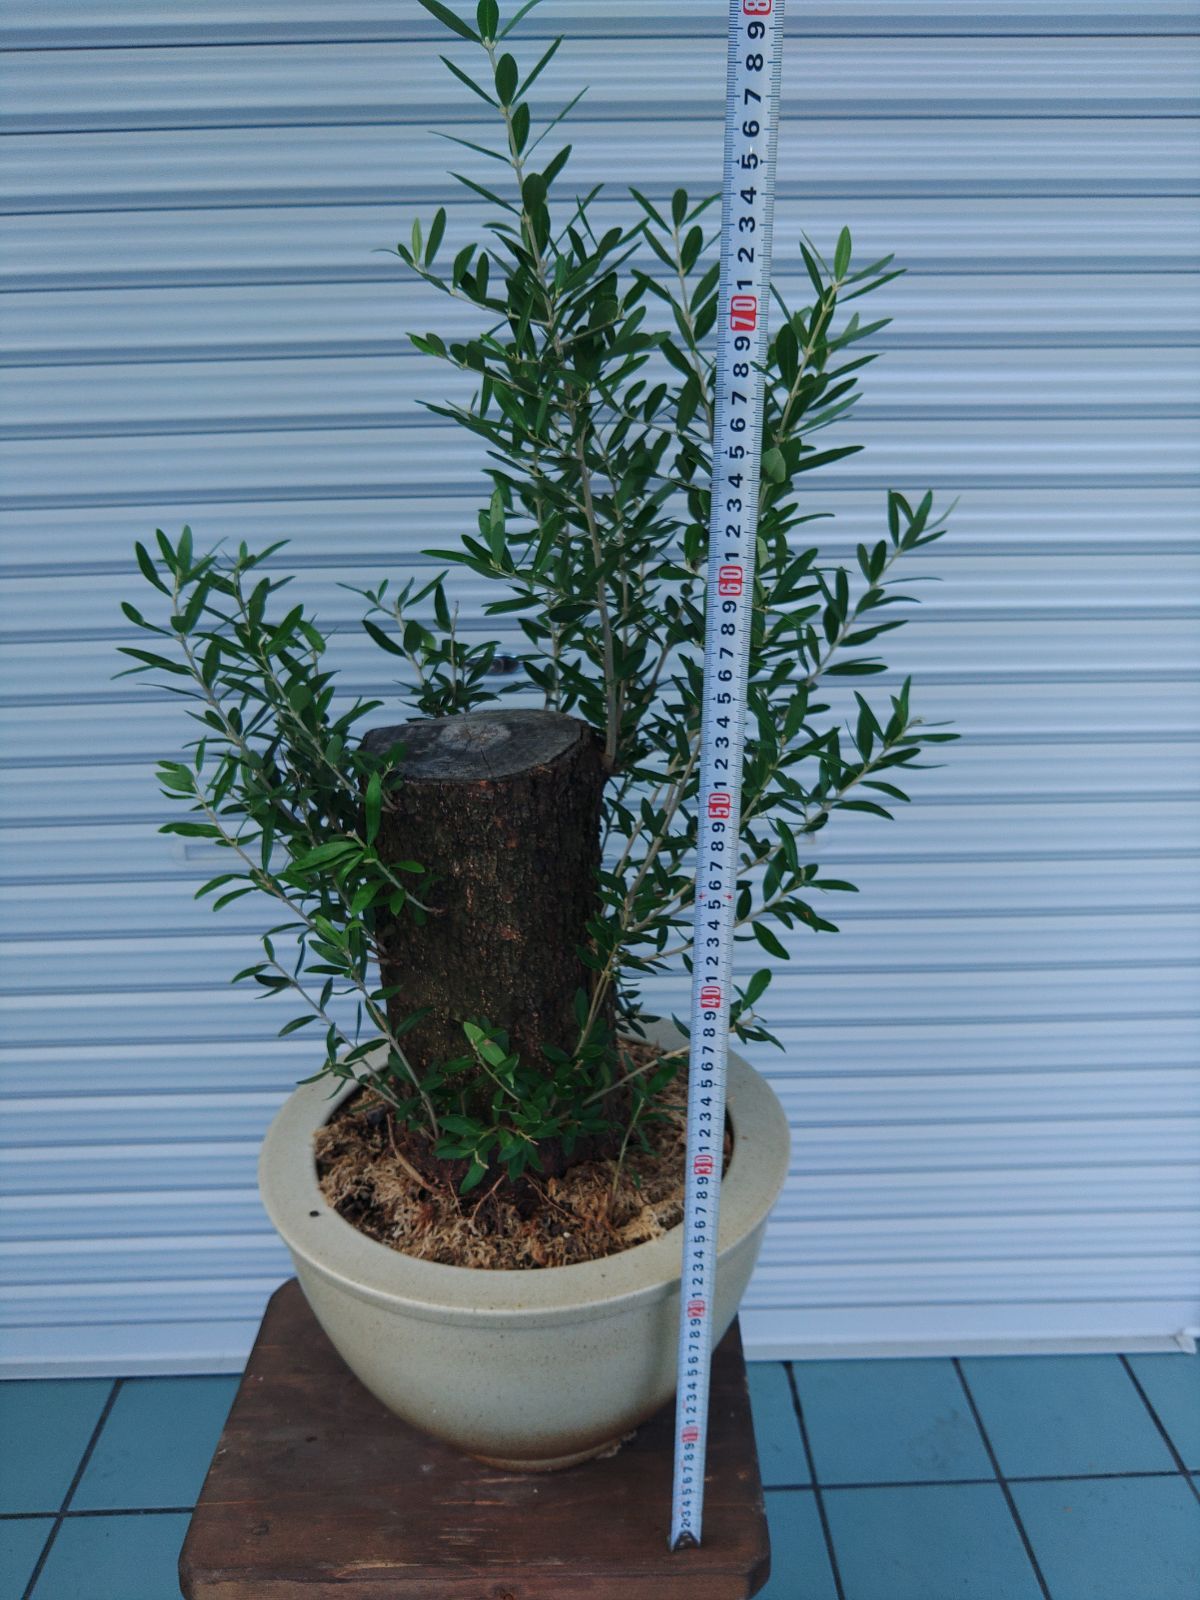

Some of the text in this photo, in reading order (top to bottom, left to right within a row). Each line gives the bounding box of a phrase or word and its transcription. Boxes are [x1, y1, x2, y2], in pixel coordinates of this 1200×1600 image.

[745, 0, 770, 12] 8
[747, 21, 765, 39] 9
[746, 53, 764, 72] 8
[744, 88, 762, 105] 7
[742, 120, 760, 137] 6
[741, 153, 758, 170] 5
[740, 186, 757, 204] 4
[739, 216, 756, 233] 3
[737, 247, 754, 263] 2
[736, 280, 753, 290] 1
[732, 297, 756, 330] 70
[734, 336, 750, 351] 9
[733, 363, 749, 378] 8
[732, 391, 747, 405] 7
[730, 417, 746, 432] 6
[729, 445, 744, 459] 5
[728, 473, 743, 488] 4
[727, 498, 742, 512] 3
[726, 525, 741, 538] 2
[725, 552, 739, 561] 1
[719, 566, 742, 596] 60
[722, 600, 737, 613] 9
[721, 623, 735, 636] 8
[720, 647, 734, 659] 7
[718, 670, 732, 681] 6
[717, 693, 731, 704] 5
[716, 716, 730, 729] 4
[715, 737, 729, 748] 3
[714, 759, 728, 770] 2
[714, 781, 727, 789] 1
[709, 793, 730, 818] 50
[712, 822, 725, 832] 9
[711, 841, 724, 852] 8
[709, 862, 723, 871] 7
[708, 880, 722, 891] 6
[708, 899, 721, 910] 5
[707, 920, 720, 931] 4
[706, 937, 719, 948] 3
[706, 956, 718, 966] 2
[701, 986, 720, 1008] 40
[704, 1011, 717, 1021] 9
[703, 1028, 716, 1037] 8
[702, 1046, 714, 1055] 7
[701, 1062, 714, 1071] 6
[701, 1079, 713, 1088] 5
[700, 1096, 712, 1106] 4
[699, 1112, 712, 1121] 3
[699, 1129, 711, 1137] 2
[697, 1176, 709, 1185] 9
[696, 1191, 708, 1199] 8
[695, 1207, 707, 1215] 7
[694, 1220, 706, 1228] 6
[694, 1235, 705, 1243] 5
[693, 1250, 705, 1259] 4
[692, 1263, 704, 1271] 3
[692, 1277, 703, 1285] 2
[690, 1318, 701, 1326] 9
[688, 1344, 699, 1352] 7
[687, 1356, 699, 1364] 6
[687, 1382, 698, 1390] 4
[686, 1394, 697, 1402] 3
